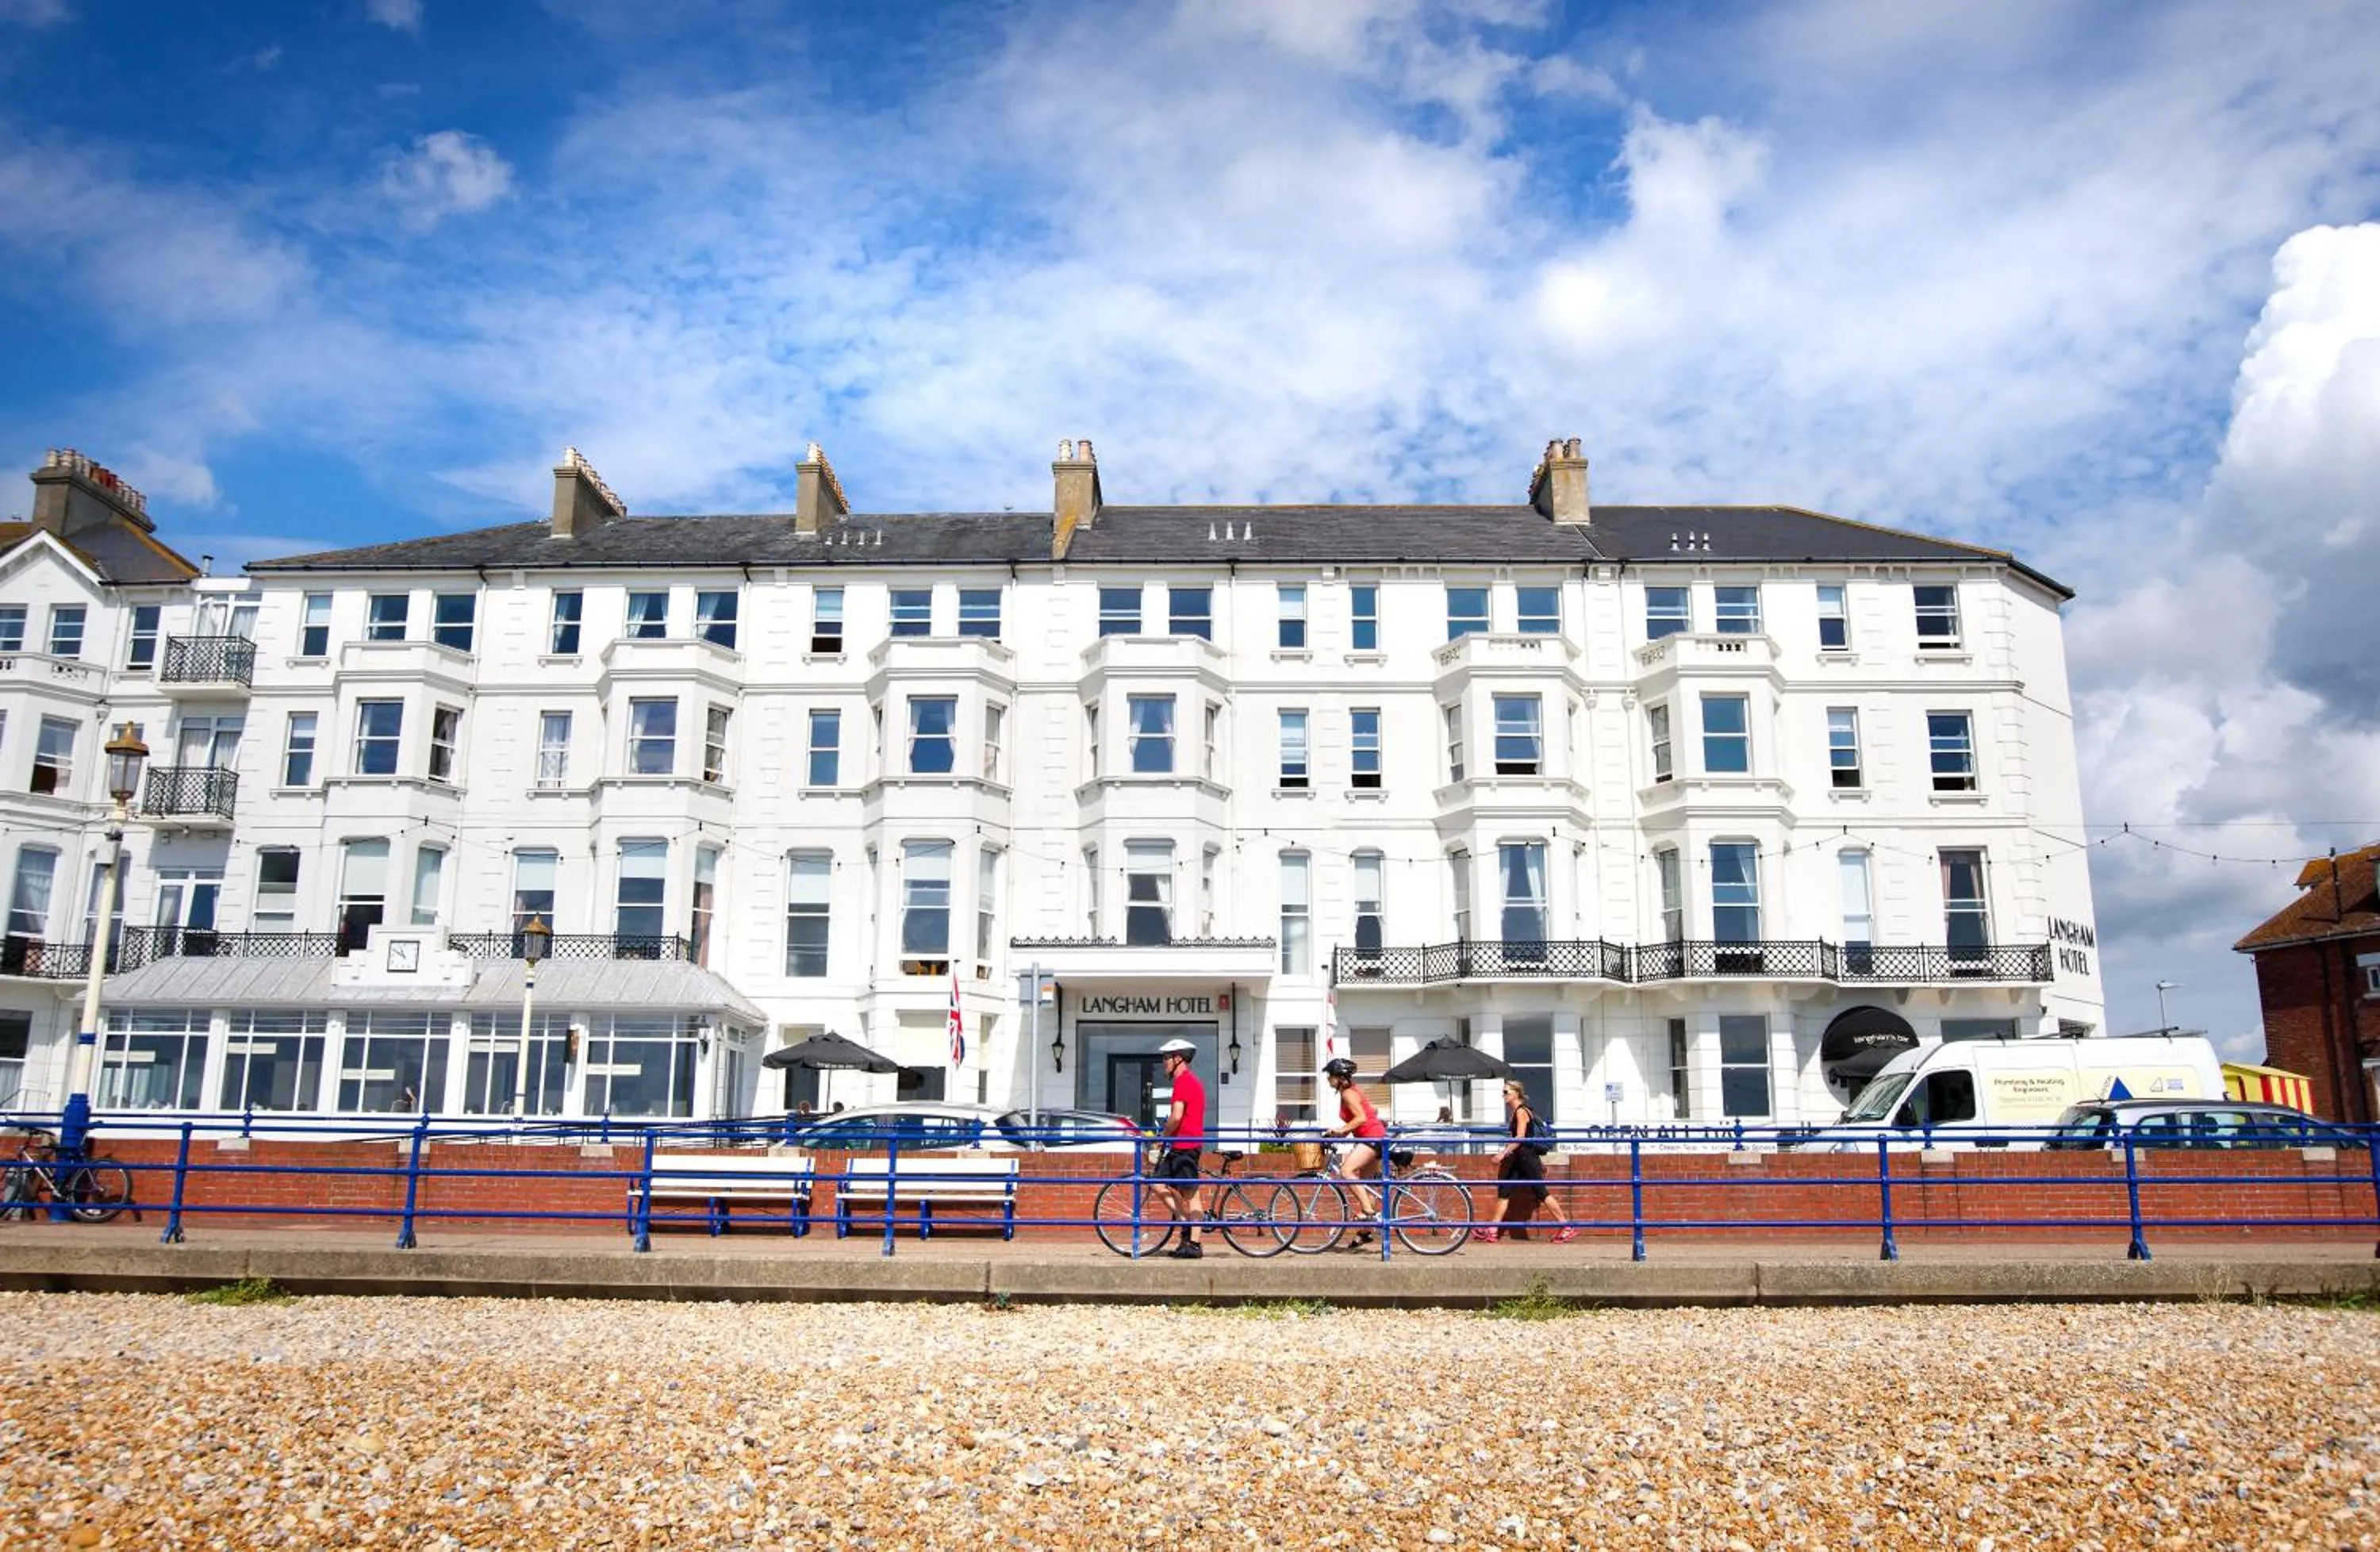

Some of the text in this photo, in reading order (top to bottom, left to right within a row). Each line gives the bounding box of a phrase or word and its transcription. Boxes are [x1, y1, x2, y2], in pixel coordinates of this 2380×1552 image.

[2048, 915, 2094, 948] LANGHAM
[2059, 947, 2090, 976] HOTEL
[1082, 997, 1214, 1014] LANGHAM HOTEL
